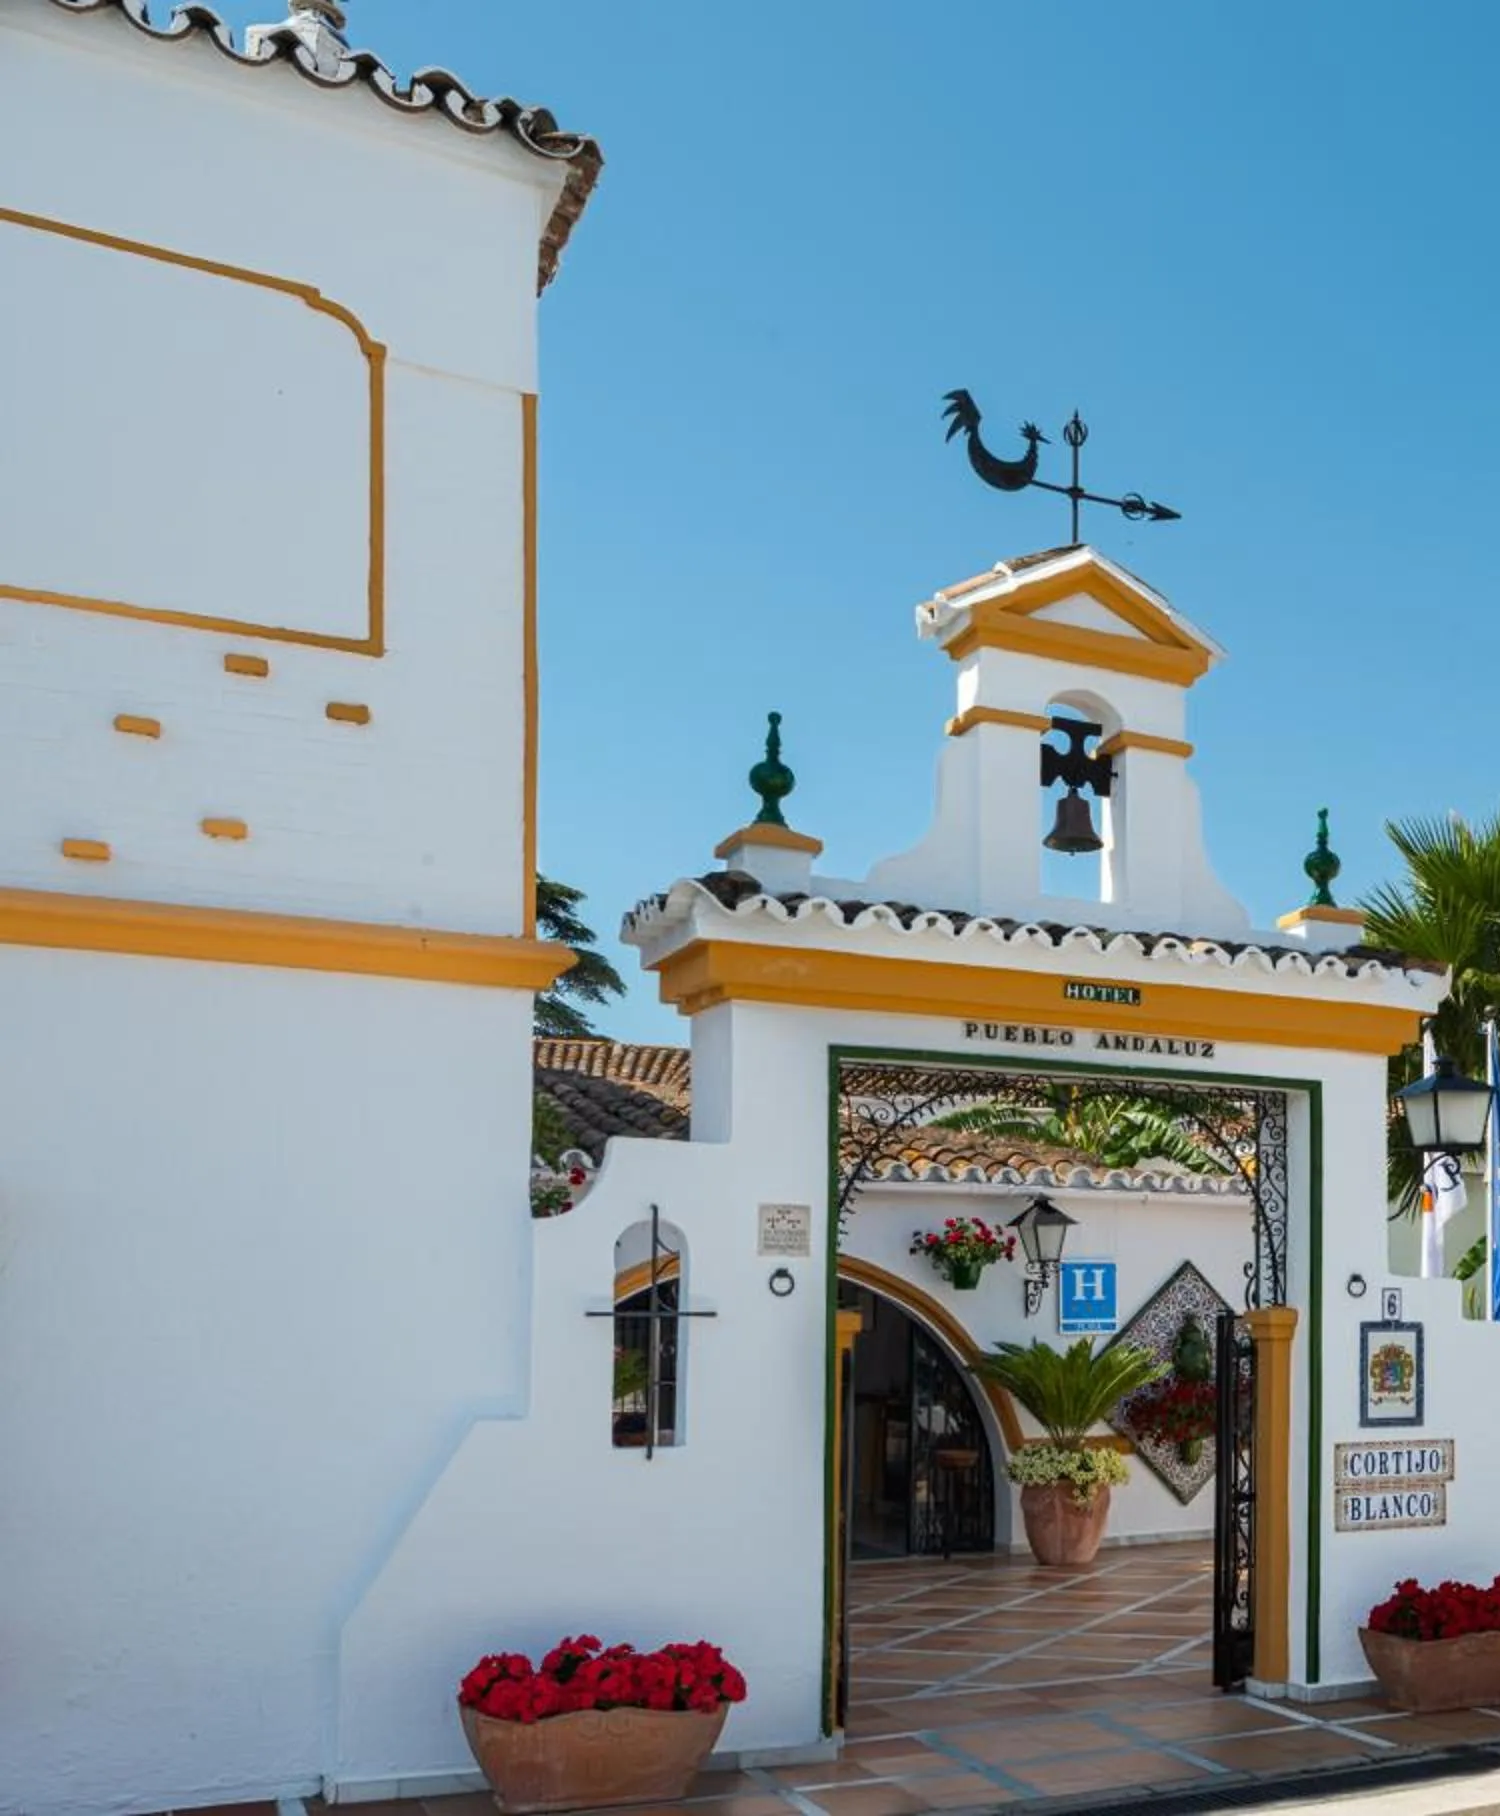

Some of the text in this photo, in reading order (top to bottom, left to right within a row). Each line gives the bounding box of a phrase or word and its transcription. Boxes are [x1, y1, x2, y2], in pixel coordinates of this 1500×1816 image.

[1066, 983, 1140, 1004] HOTEL
[964, 1022, 1217, 1058] PUEBLO ANDALUZ
[1072, 1269, 1107, 1301] H
[1387, 1293, 1397, 1316] 6
[1350, 1449, 1441, 1477] CORTIJO
[1350, 1493, 1432, 1522] BLANCO
